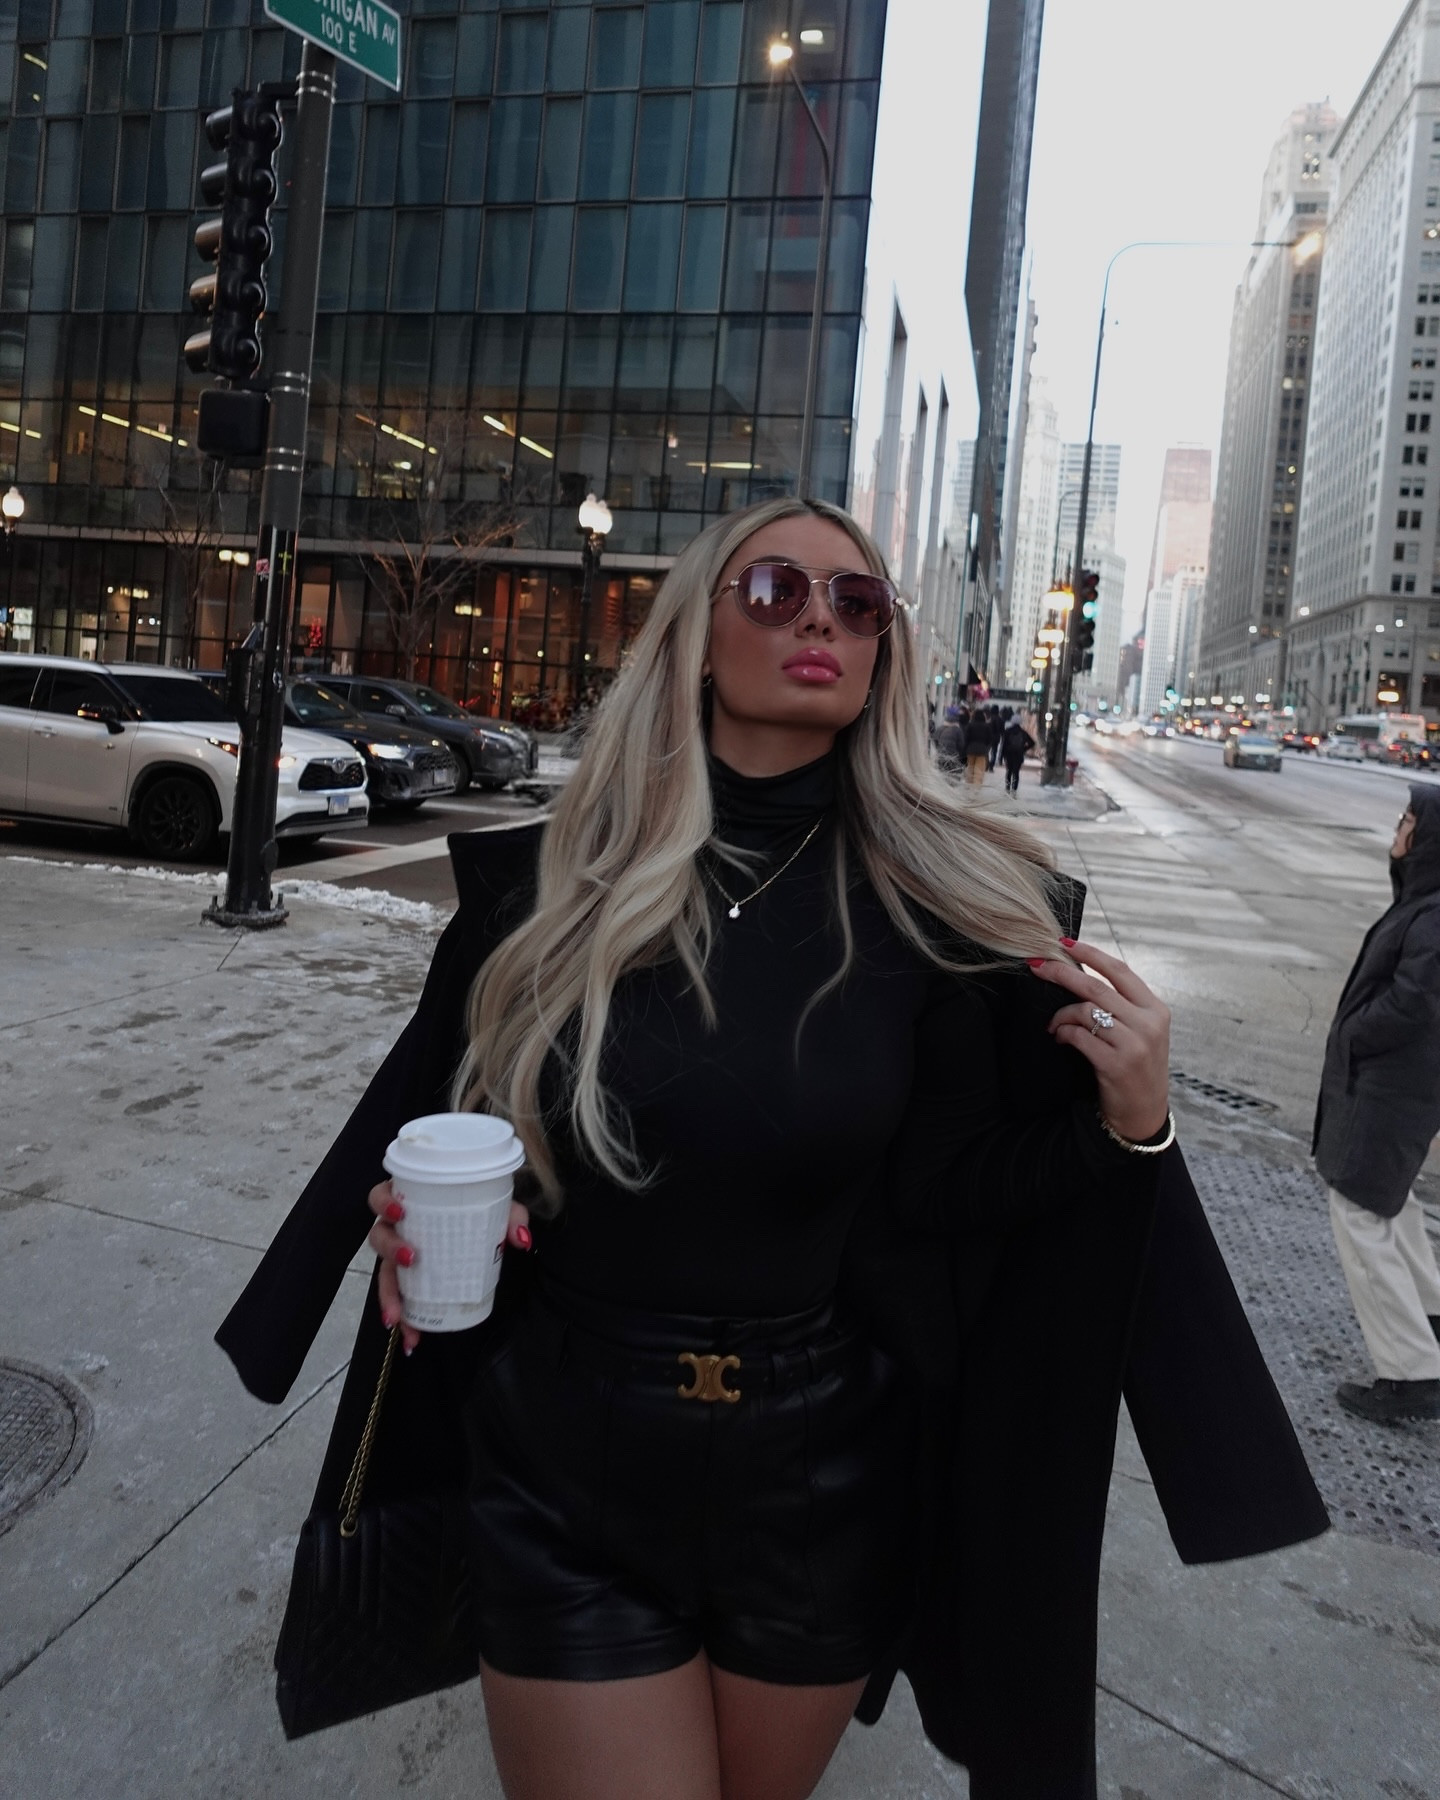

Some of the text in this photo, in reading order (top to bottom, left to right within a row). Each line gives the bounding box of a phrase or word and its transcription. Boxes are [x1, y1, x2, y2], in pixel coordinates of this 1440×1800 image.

[321, 13, 357, 53] 100 E
[382, 23, 395, 46] AV
